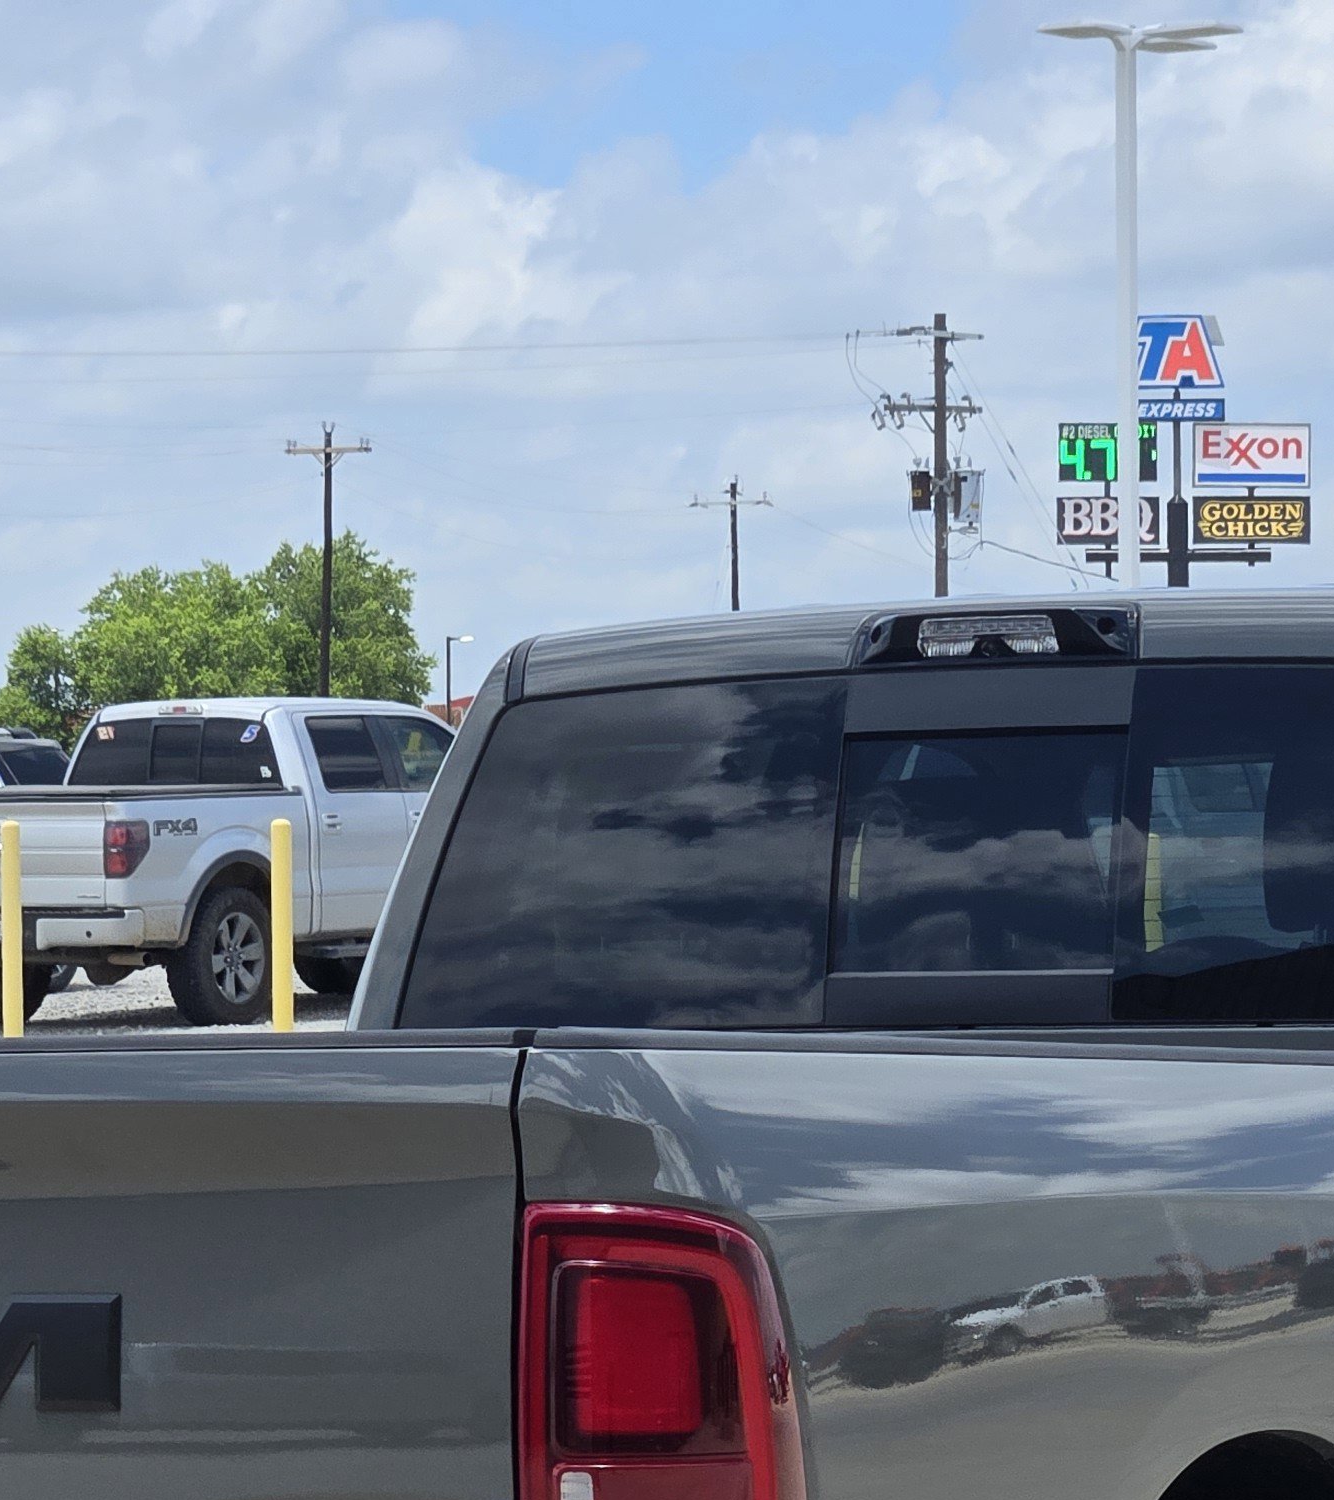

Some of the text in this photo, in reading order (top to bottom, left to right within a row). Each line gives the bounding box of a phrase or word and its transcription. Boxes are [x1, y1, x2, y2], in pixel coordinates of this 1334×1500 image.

[1138, 321, 1215, 381] TA
[1137, 402, 1217, 418] EXPRESS
[1078, 425, 1111, 438] DIESEL
[1202, 430, 1303, 469] Exxon
[1202, 501, 1302, 521] GOLDEN
[1210, 520, 1287, 537] CHICK
